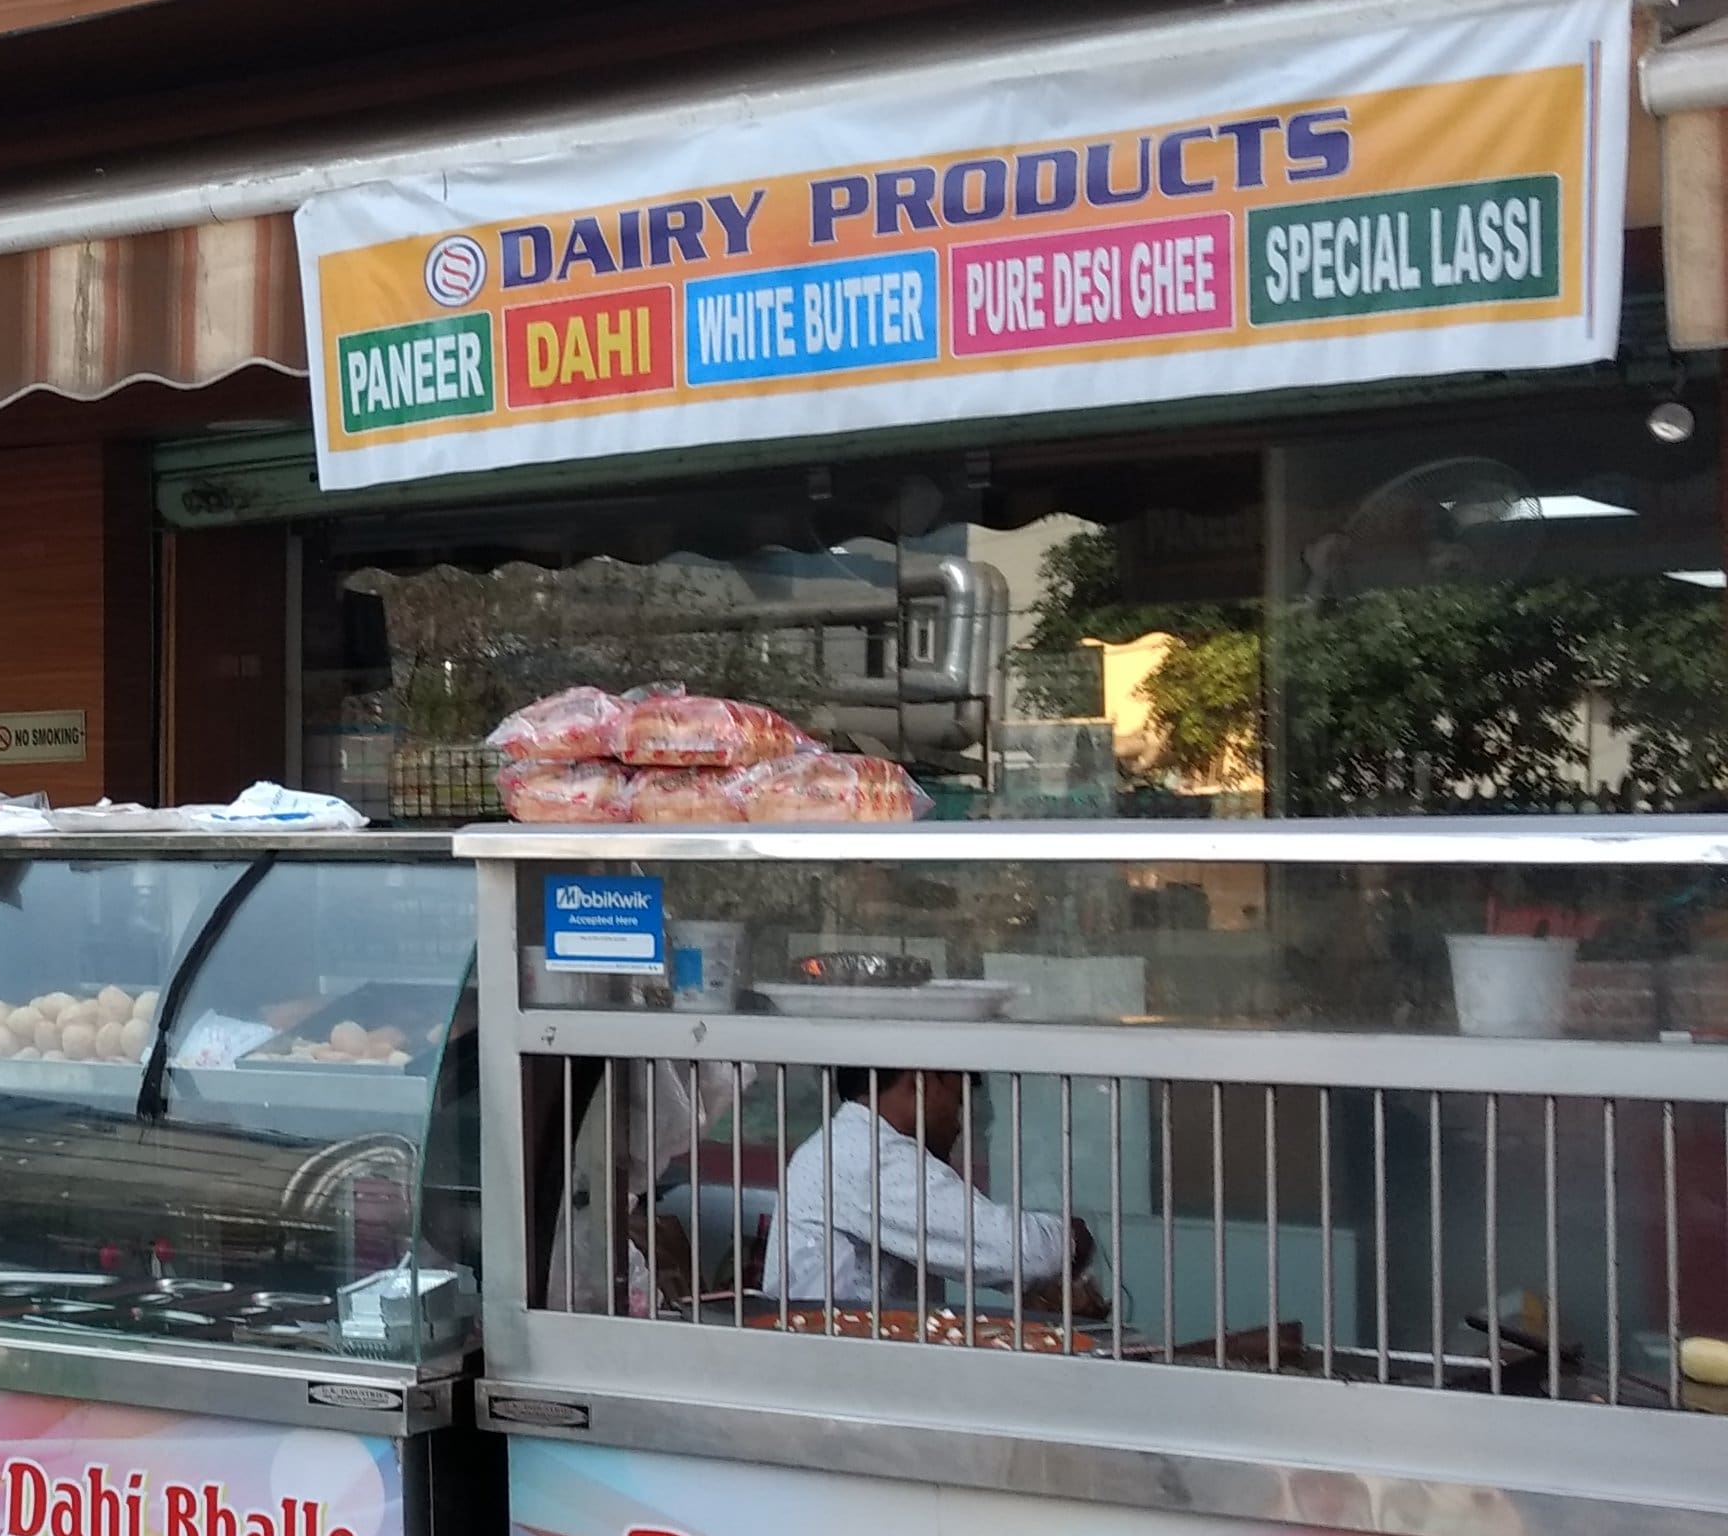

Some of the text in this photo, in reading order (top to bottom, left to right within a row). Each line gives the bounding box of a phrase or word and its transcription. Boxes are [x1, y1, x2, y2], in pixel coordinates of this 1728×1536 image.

[499, 107, 1352, 291] DAIRY PRODUCTS
[966, 234, 1217, 337] PURE DESI GHEE
[1265, 196, 1542, 305] SPECIAL LASSI
[526, 306, 651, 390] DAHI
[698, 270, 925, 366] WHITE BUTTER
[346, 332, 485, 417] PANEER
[15, 727, 79, 746] NO SMOKING
[556, 885, 648, 910] MobiKwik
[569, 914, 639, 926] Accepted Here
